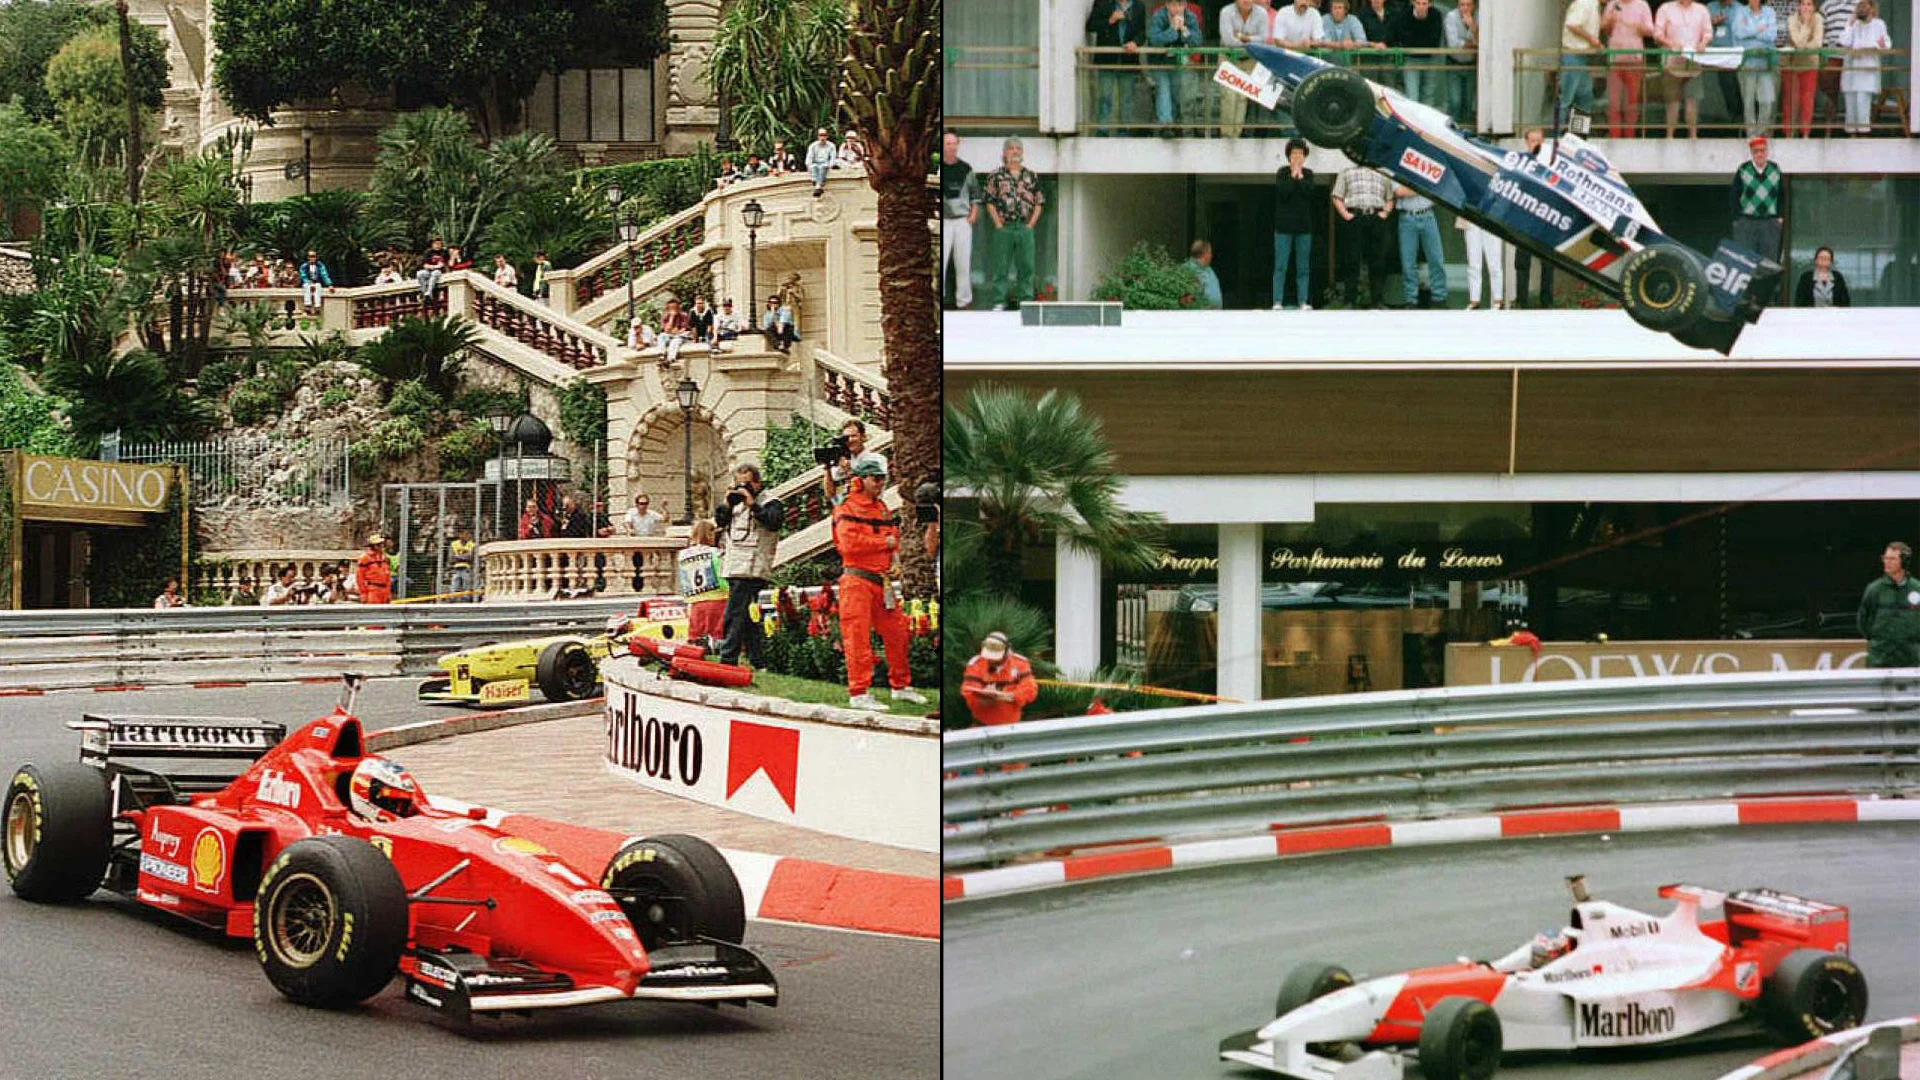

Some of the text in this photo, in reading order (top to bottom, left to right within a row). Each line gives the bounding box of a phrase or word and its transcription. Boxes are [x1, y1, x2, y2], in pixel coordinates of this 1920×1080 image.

[1218, 68, 1262, 98] SONAX
[1402, 151, 1442, 179] SANYO
[1554, 159, 1635, 215] Rothmans
[1704, 261, 1753, 296] elf
[25, 460, 166, 508] CASINO
[1270, 546, 1504, 573] Parfumerie du Loews
[694, 568, 705, 588] 6
[1580, 1001, 1676, 1038] Marlboro
